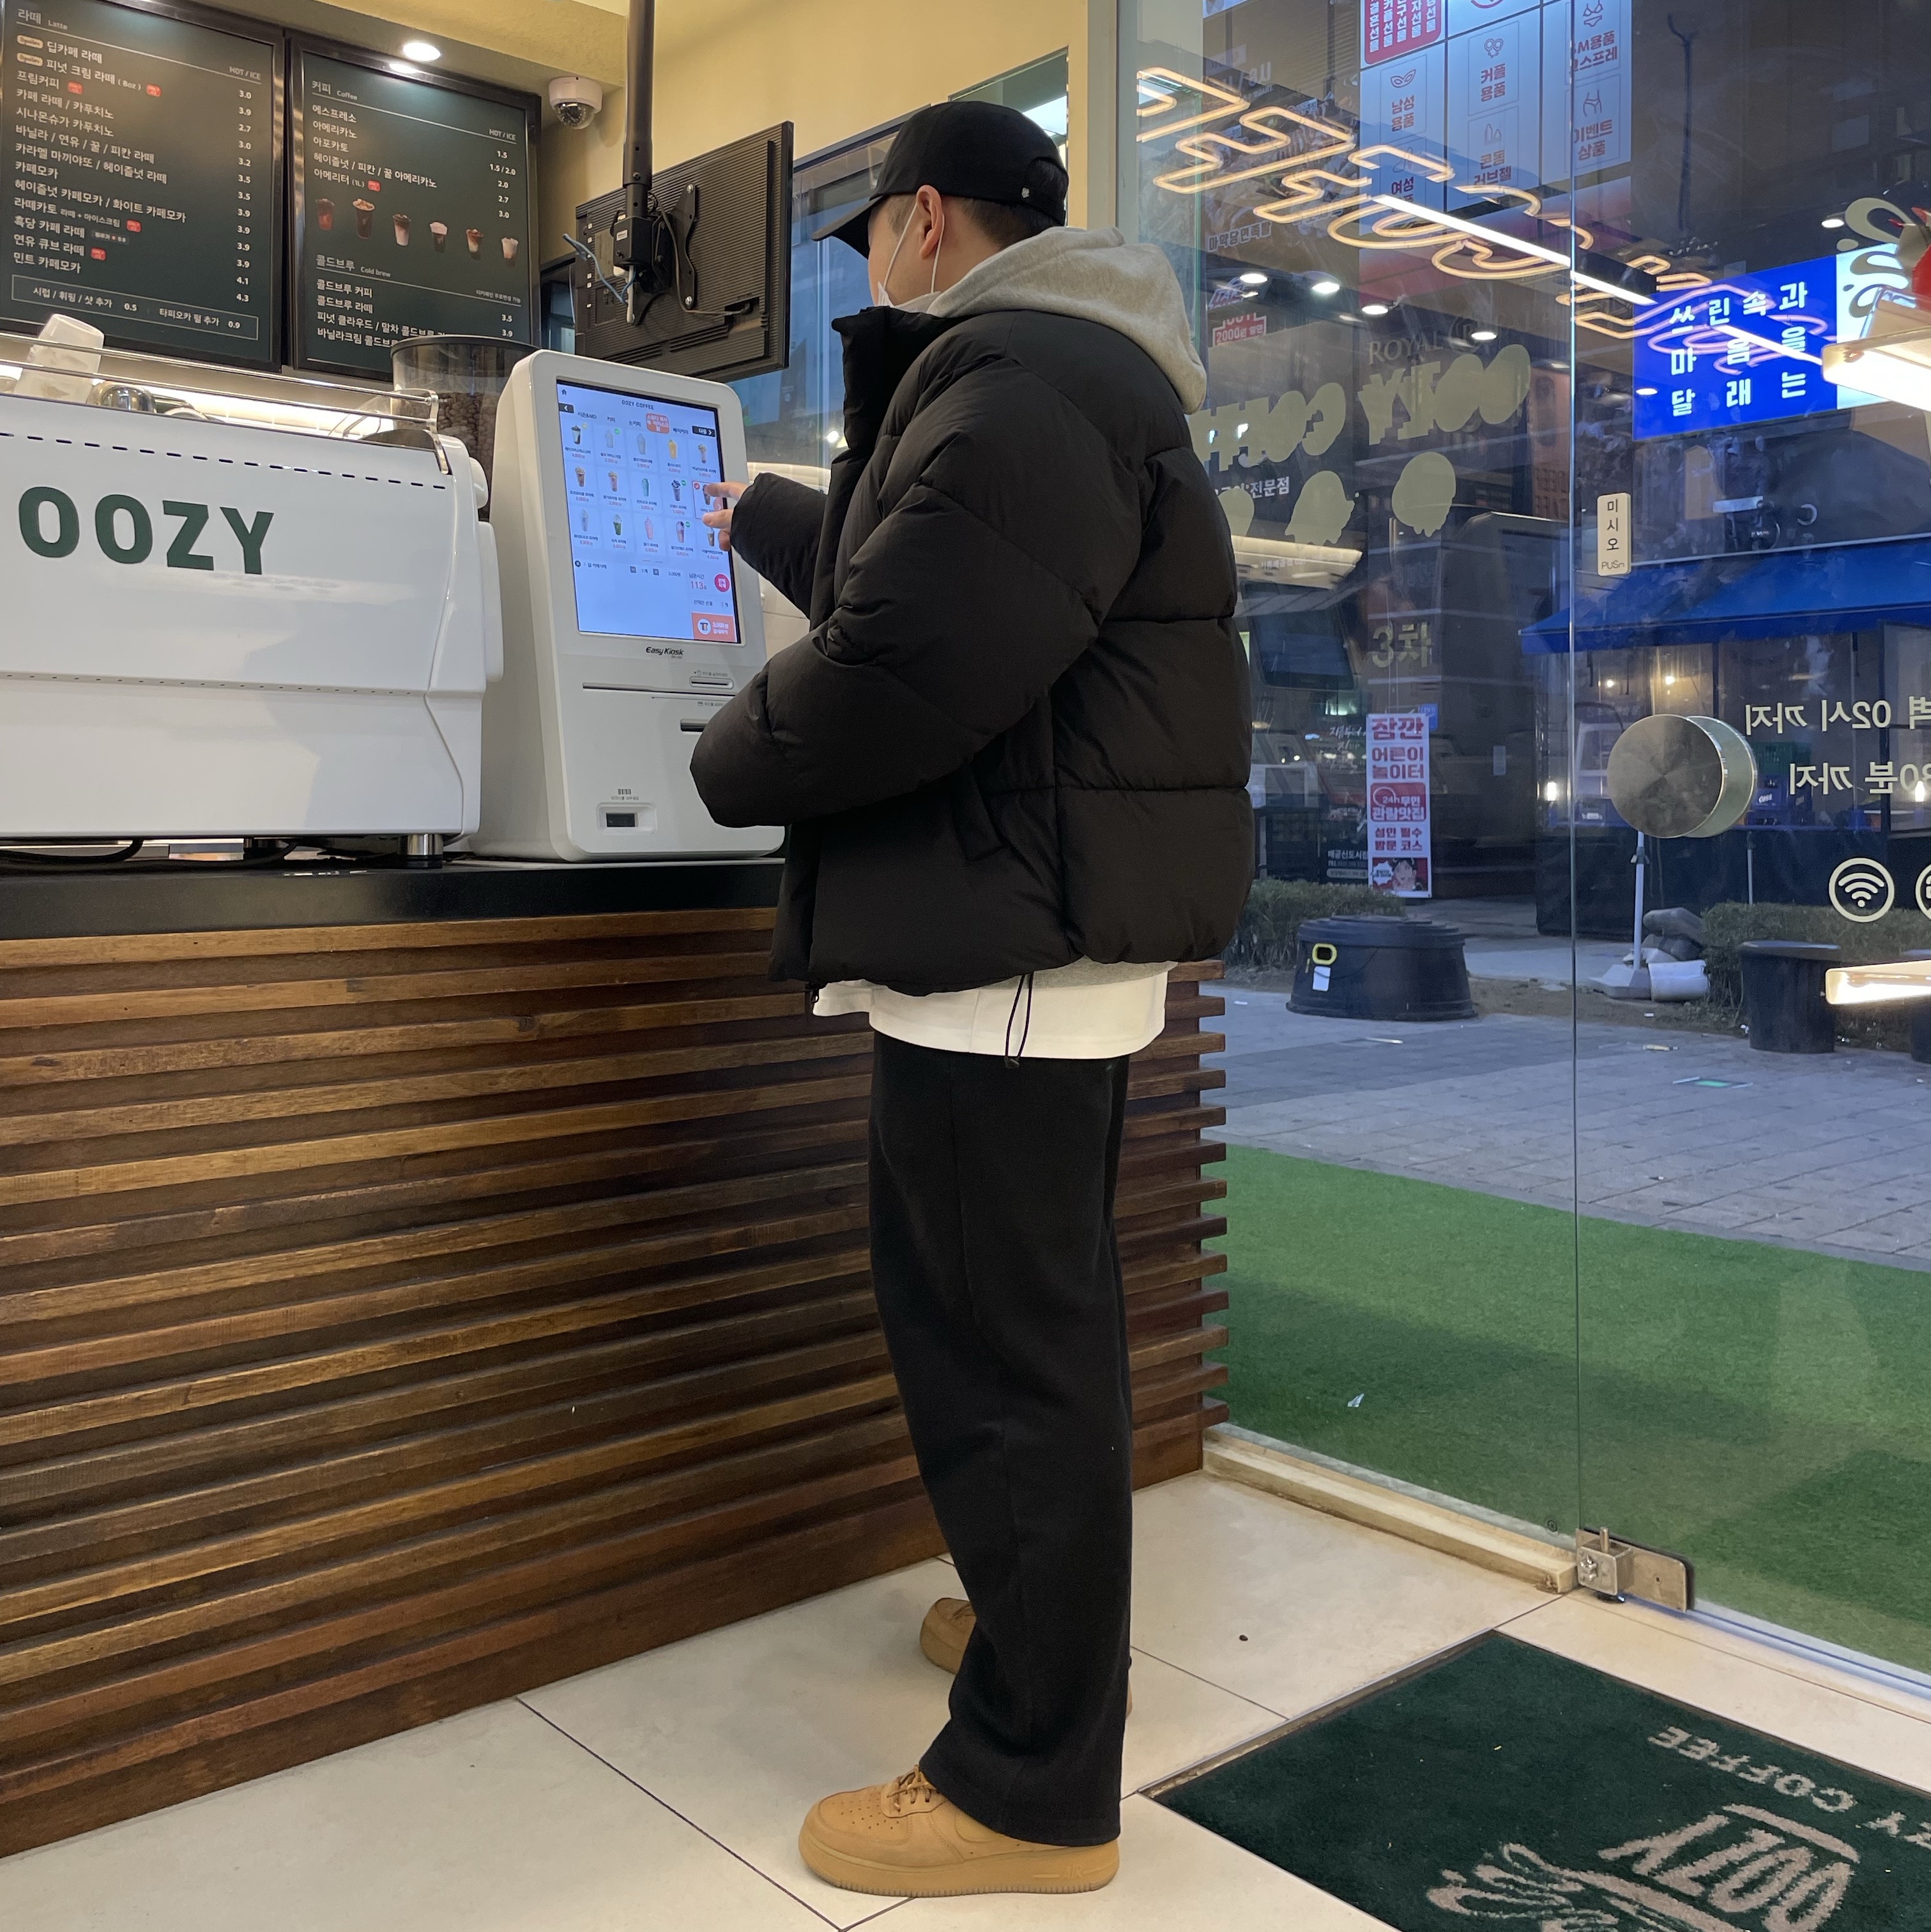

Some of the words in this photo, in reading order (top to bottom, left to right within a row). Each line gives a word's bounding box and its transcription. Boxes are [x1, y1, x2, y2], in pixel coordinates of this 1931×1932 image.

[18, 8, 42, 25] 라떼
[48, 20, 68, 31] Latte
[47, 41, 78, 58] 딥카페
[81, 50, 102, 64] 라떼
[239, 90, 252, 100] 3.0
[47, 59, 67, 74] 피넛
[70, 65, 91, 80] 크림
[95, 71, 116, 85] 라떼
[239, 107, 252, 116] 3.9
[229, 66, 245, 76] HOT
[312, 80, 331, 95] 커피
[337, 90, 358, 101] Coffee
[1481, 63, 1506, 84] 커플
[1481, 81, 1506, 102] 용품
[17, 70, 59, 89] 프림커피
[239, 124, 252, 133] 2.7
[17, 88, 38, 103] 카페
[41, 95, 63, 109] 라떼
[73, 102, 114, 119] 카푸치노
[238, 141, 252, 150] 3.0
[1392, 95, 1414, 114] 남성
[1392, 112, 1414, 132] 용품
[15, 125, 48, 142] 바닐라
[59, 134, 79, 148] 연유
[90, 141, 101, 153] 꿀
[111, 146, 132, 160] 피칸
[134, 149, 155, 164] 라떼
[238, 174, 251, 184] 3.5
[17, 107, 70, 128] 시나몬슈가
[73, 119, 114, 138] 카푸치노
[238, 157, 251, 167] 3.2
[312, 104, 357, 124] 에스프레소
[497, 150, 508, 159] 1.5
[312, 121, 357, 139] 아메리카노
[490, 164, 501, 173] 1.5
[505, 167, 516, 176] 2.0
[489, 128, 502, 138] HOT
[1578, 140, 1605, 161] 상품
[15, 142, 48, 160] 카라멜
[103, 161, 144, 180] 헤이즐넛
[147, 169, 167, 185] 라떼
[238, 192, 251, 201] 3.5
[313, 135, 349, 153] 아포카토
[498, 180, 508, 189] 2.0
[314, 152, 349, 170] 헤이즐넛
[358, 162, 376, 175] 피칸
[384, 168, 392, 179] 꿀
[395, 170, 437, 189] 아메리카노
[498, 195, 509, 204] 2.7
[15, 161, 59, 180] 카페모카
[238, 208, 250, 218] 3.9
[15, 179, 57, 197] 헤이즐넛
[61, 187, 103, 206] 카페모카
[112, 197, 144, 215] 화이트
[147, 205, 187, 224] 카페모카
[238, 225, 250, 235] 3.9
[314, 168, 350, 186] 아메리터
[498, 210, 510, 219] 3.0
[1391, 177, 1414, 195] 여성
[14, 197, 57, 215] 라떼카토
[84, 213, 121, 228] 아이스크림
[237, 243, 250, 252] 3.9
[14, 215, 36, 230] 흑당
[39, 219, 60, 234] 카페
[63, 225, 85, 239] 라떼
[237, 259, 250, 269] 3.9
[13, 233, 35, 248] 연유
[39, 238, 60, 251] 큐브
[63, 242, 85, 257] 라떼
[236, 276, 249, 285] 4.1
[13, 252, 35, 265] 민트
[38, 256, 81, 274] 카페모카
[236, 293, 249, 303] 4.3
[316, 254, 355, 271] 콜드브루
[360, 266, 374, 275] Cold
[33, 287, 50, 298] 시럽
[84, 296, 93, 306] 샷
[96, 297, 112, 308] 추가
[124, 303, 137, 312] 0.5
[159, 308, 191, 322] 타피오카
[203, 316, 220, 326] 추가
[228, 321, 241, 330] 0.9
[317, 278, 352, 294] 콜드브루
[355, 285, 372, 298] 커피
[501, 314, 513, 323] 3.5
[317, 294, 353, 310] 콜드브루
[355, 301, 374, 314] 라떼
[501, 329, 513, 337] 3.9
[317, 311, 335, 324] 피넛
[338, 314, 372, 330] 클라우드
[381, 321, 399, 334] 말차
[317, 327, 362, 346] 바닐라크림
[622, 399, 635, 407] OOZY
[636, 402, 655, 410] COFFEE
[18, 486, 275, 575] OOZY
[1606, 499, 1621, 552] 미시오
[1371, 621, 1431, 668] 3차
[1371, 717, 1424, 741] 잠깐
[1372, 764, 1424, 779] 놀이터
[1400, 840, 1423, 851] 코스
[1649, 1726, 1856, 1812] COFFEE
